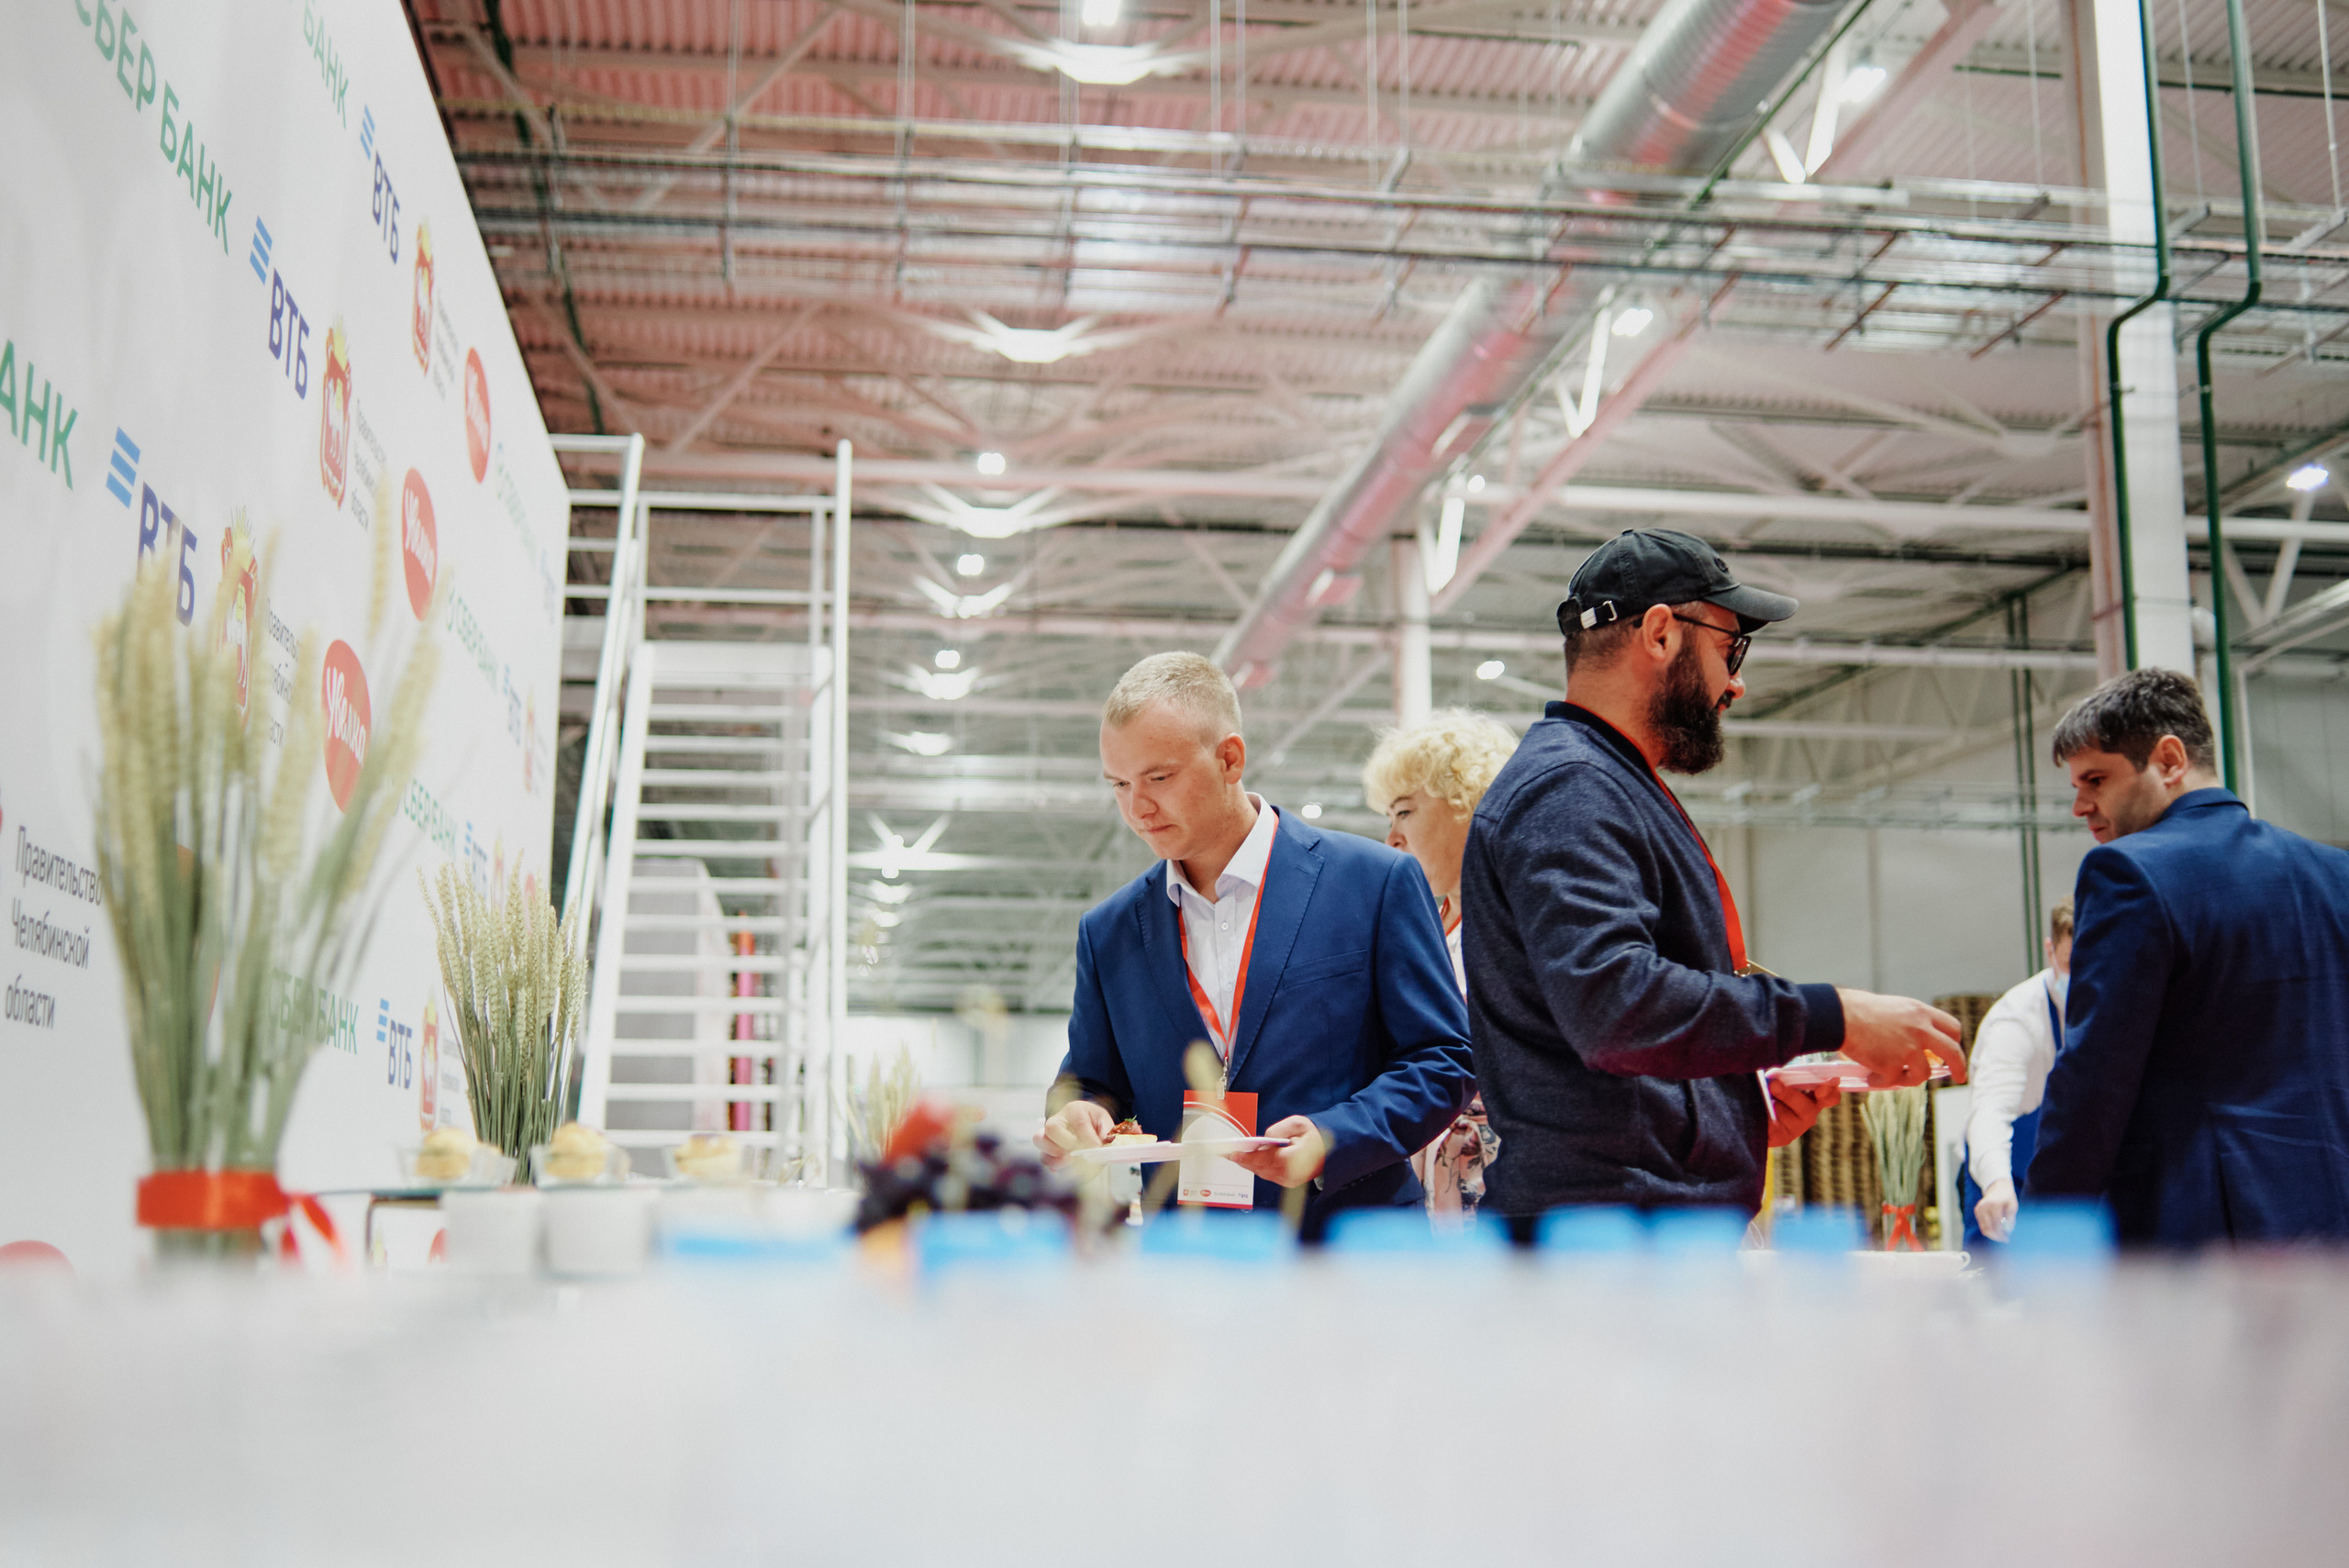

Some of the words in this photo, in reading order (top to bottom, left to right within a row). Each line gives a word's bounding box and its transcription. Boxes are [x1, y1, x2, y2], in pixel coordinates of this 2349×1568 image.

[373, 150, 400, 263] ВТБ
[268, 267, 310, 400] ВТБ
[0, 339, 78, 492] АНК
[327, 666, 366, 769] Увелка
[16, 824, 102, 906] Правительство
[13, 896, 90, 969] Челябинской
[6, 973, 55, 1029] области
[388, 1019, 412, 1089] ВТБ
